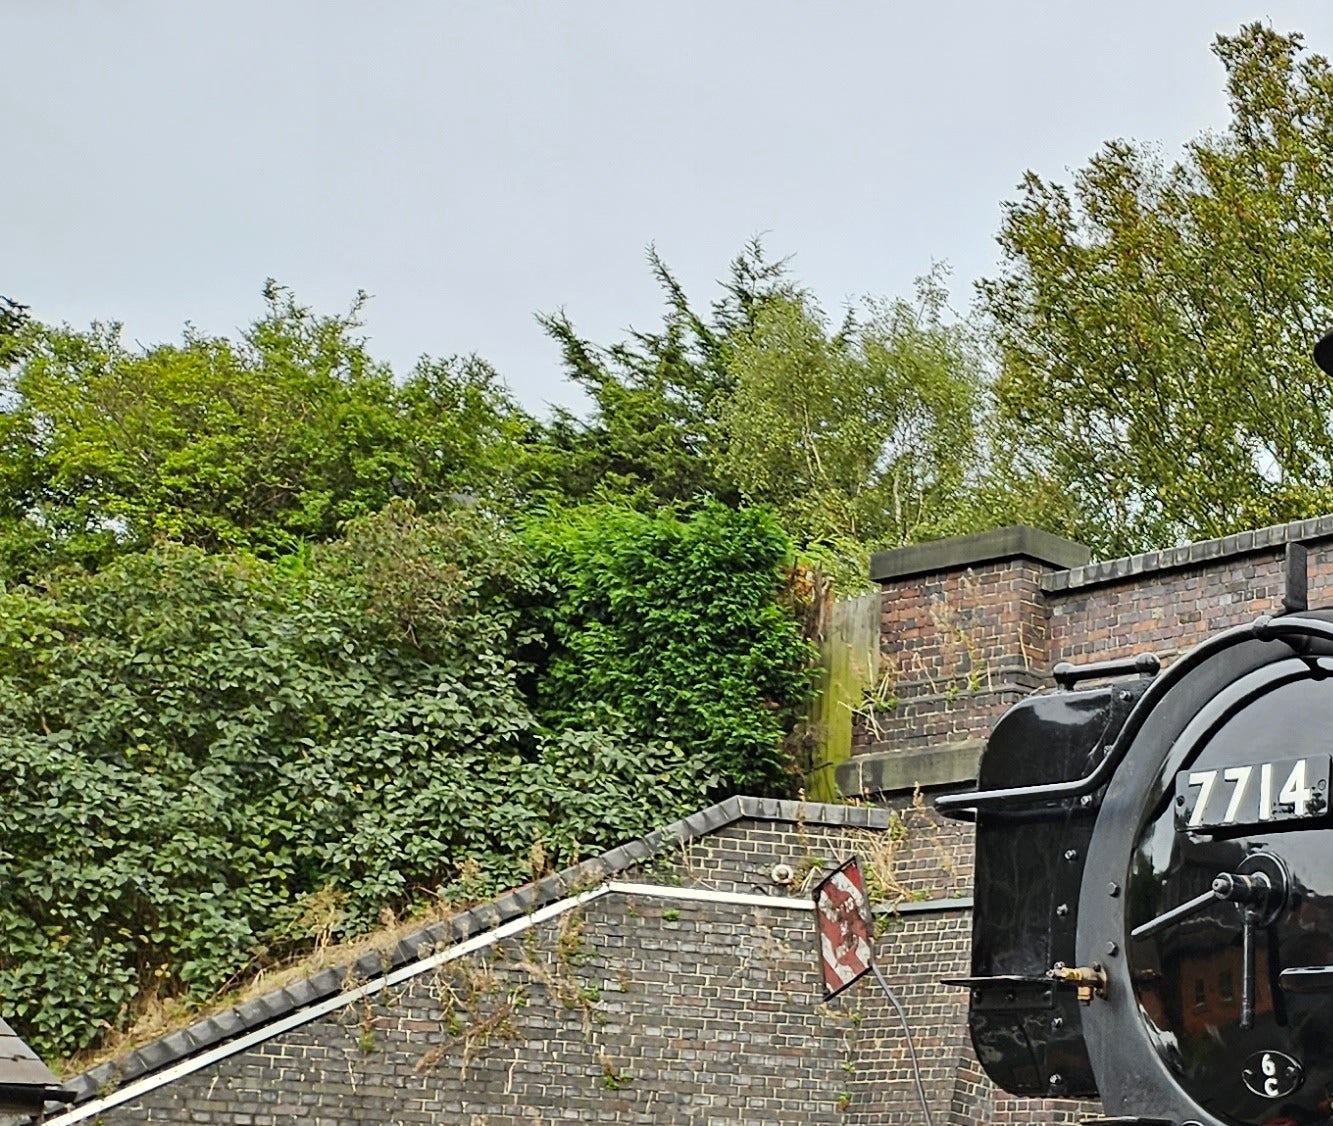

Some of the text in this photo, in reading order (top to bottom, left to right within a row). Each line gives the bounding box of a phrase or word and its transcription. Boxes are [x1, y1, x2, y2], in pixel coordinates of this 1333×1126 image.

[1188, 758, 1311, 827] 7714
[1261, 1053, 1276, 1076] 6
[1264, 1077, 1279, 1096] C
